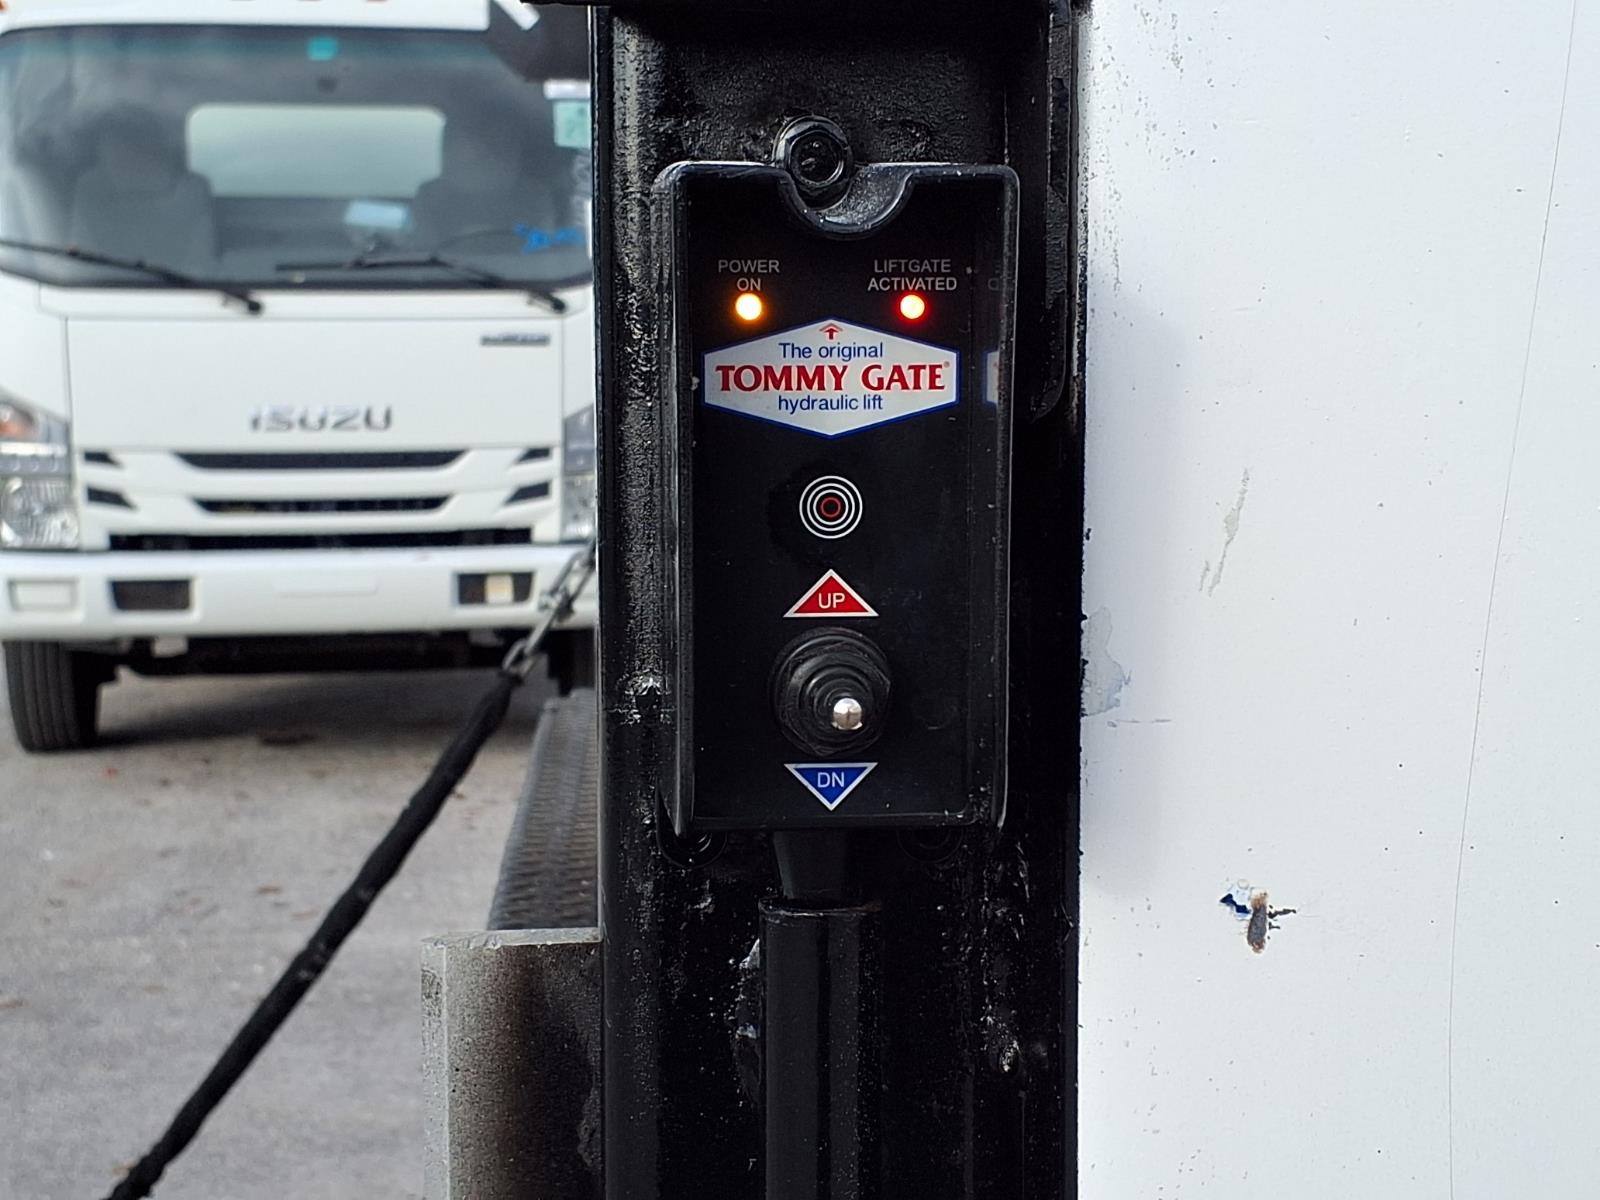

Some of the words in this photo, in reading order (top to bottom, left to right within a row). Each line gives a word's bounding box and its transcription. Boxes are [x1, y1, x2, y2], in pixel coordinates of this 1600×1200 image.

[717, 259, 780, 273] POWER
[873, 258, 951, 273] LIFTGATE
[736, 277, 762, 291] ON
[867, 276, 957, 291] ACTIVATED
[778, 342, 812, 359] The
[818, 342, 883, 362] original
[715, 364, 848, 391] TOMMY
[861, 364, 945, 391] GATE
[778, 394, 859, 415] hydraulic
[862, 394, 883, 411] lift
[248, 403, 392, 432] ISUZU
[818, 592, 846, 609] UP
[817, 772, 846, 789] DN
